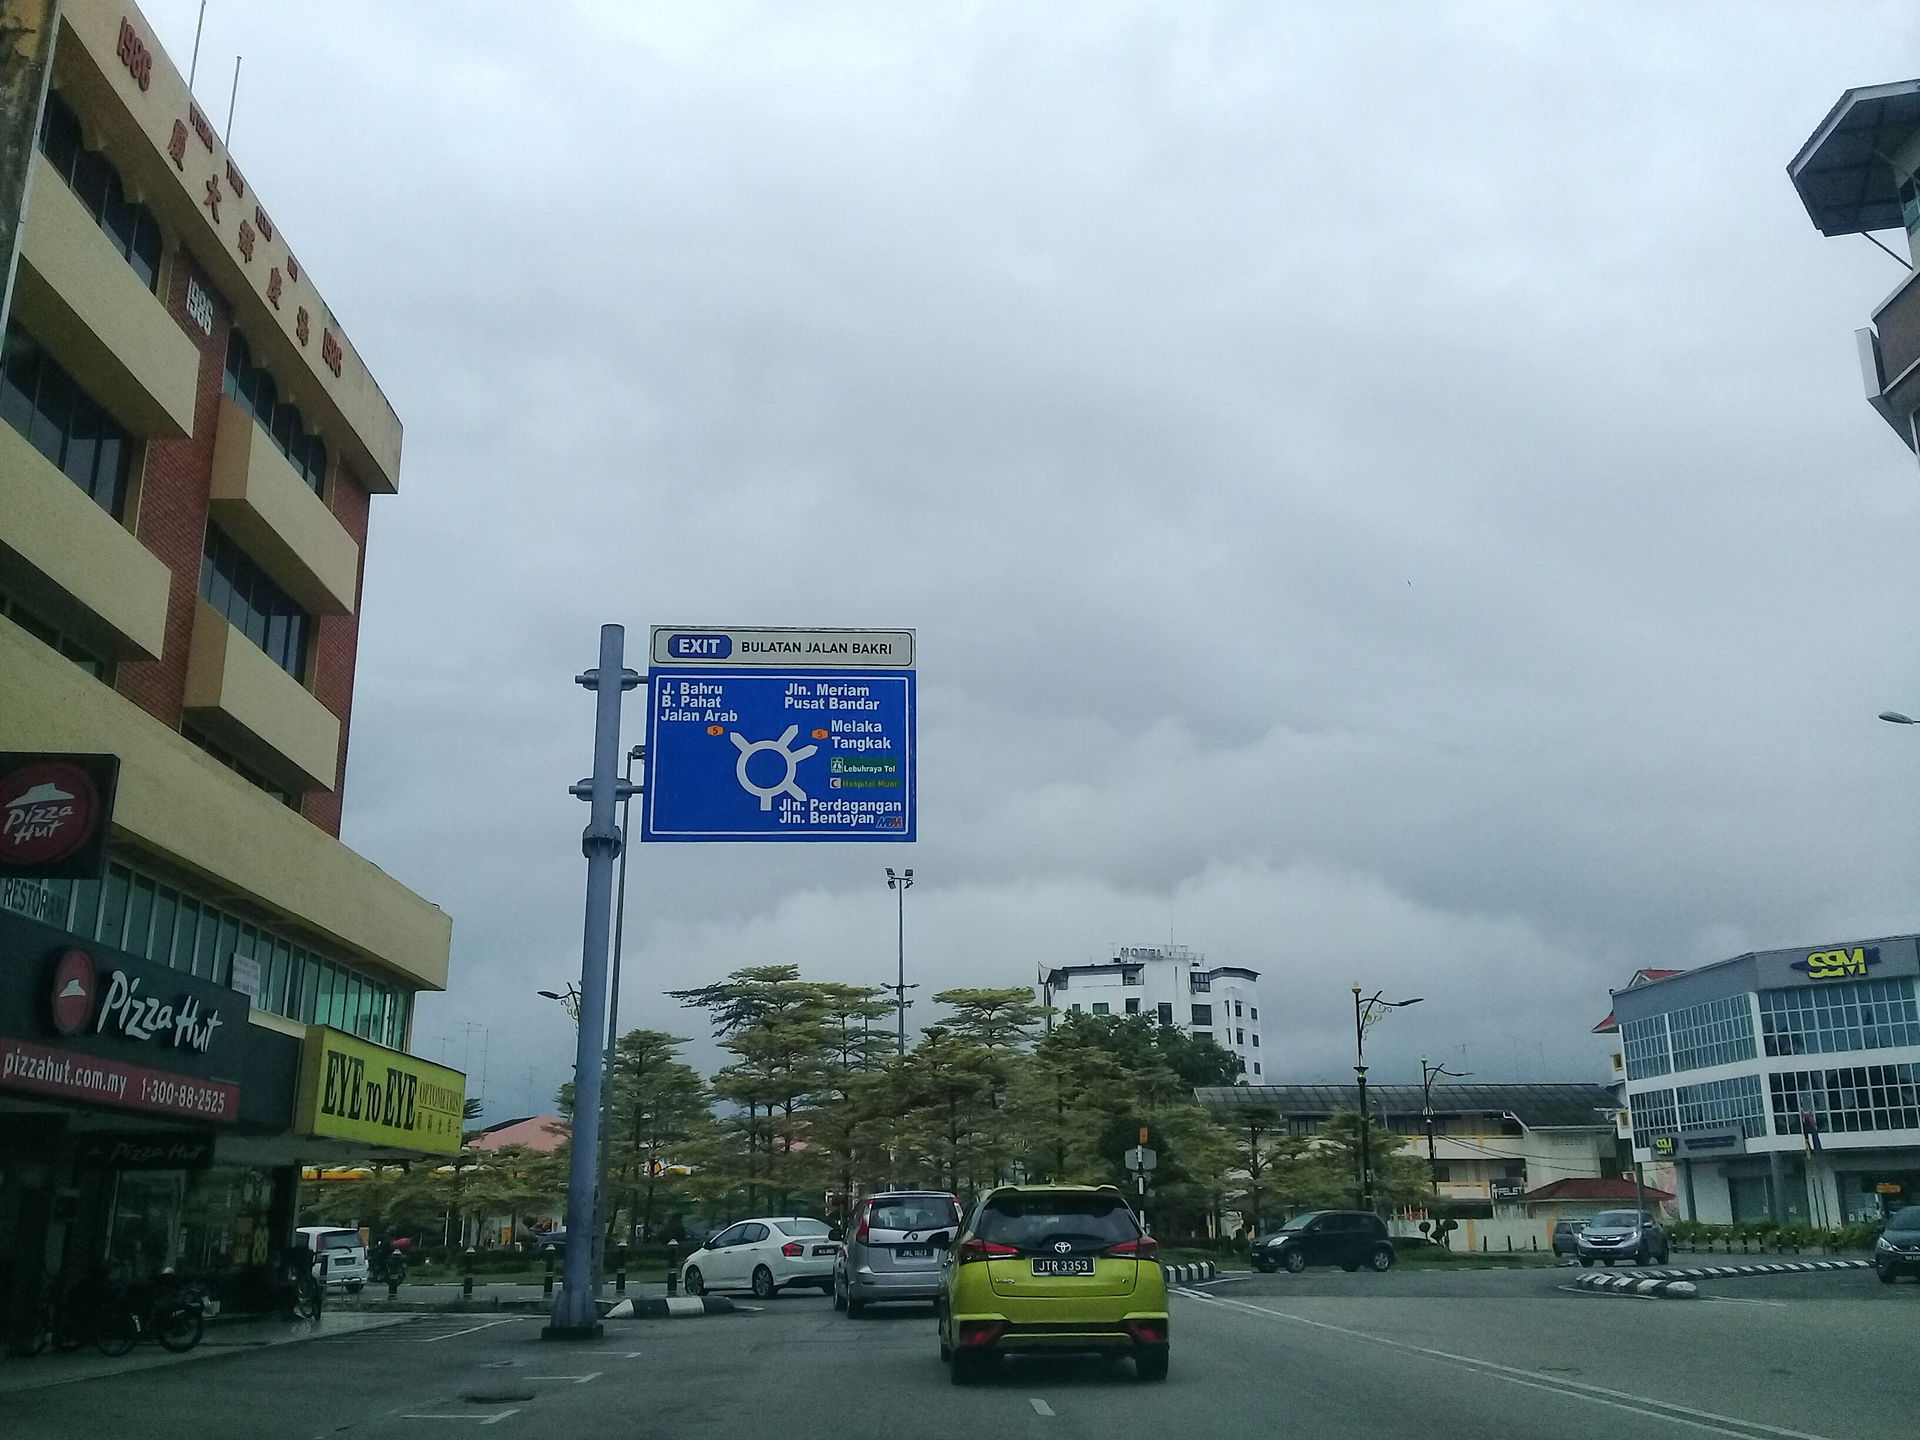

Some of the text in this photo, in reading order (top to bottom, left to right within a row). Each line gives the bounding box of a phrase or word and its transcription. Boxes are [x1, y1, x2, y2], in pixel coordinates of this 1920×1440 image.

[116, 16, 152, 92] 1986
[186, 275, 213, 336] 1986
[322, 328, 342, 378] 1986
[679, 639, 720, 653] EXIT
[742, 642, 892, 655] BULATAN JALAN BAKRI
[662, 682, 723, 695] J. Bahru
[784, 683, 870, 697] Jln. Meriam
[661, 695, 721, 708] B. Pahat
[784, 696, 880, 710] Pusat Bandar
[660, 709, 738, 722] Jalan Arab
[831, 719, 883, 733] Melaka
[831, 736, 892, 752] Tangkak
[843, 764, 896, 774] Lebuhraya Tol
[779, 799, 902, 814] Jln. Perdagangan
[3, 805, 74, 834] Pizza
[779, 811, 874, 827] Jln. Bentayan
[14, 820, 64, 845] Hut
[97, 970, 172, 1040] Pizza
[174, 995, 223, 1053] Hut
[3, 1048, 225, 1113] pizzahut.com.my 1-300-88-2525
[321, 1049, 364, 1120] EYE
[382, 1067, 417, 1131] EYE
[1038, 1260, 1088, 1272] JTR 3353
